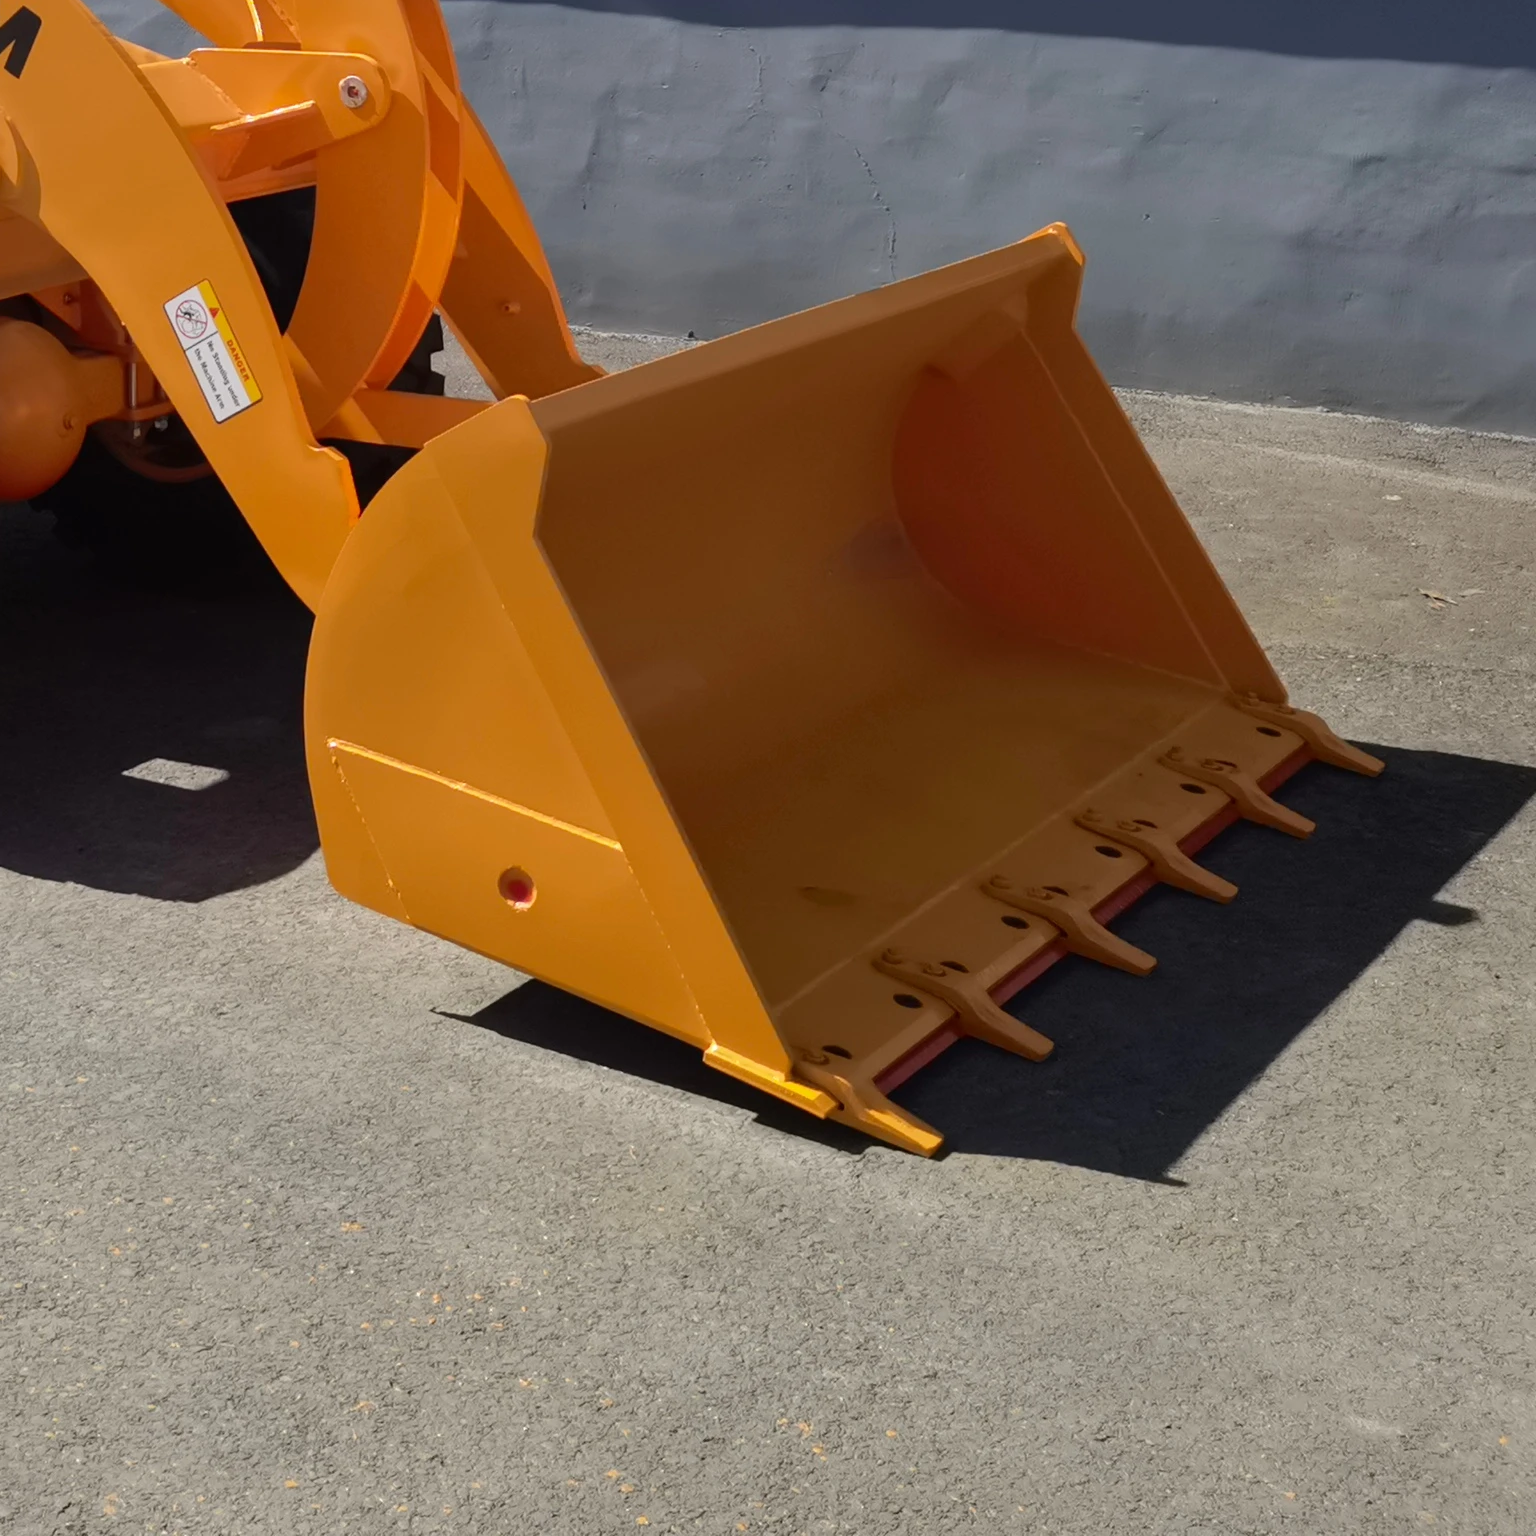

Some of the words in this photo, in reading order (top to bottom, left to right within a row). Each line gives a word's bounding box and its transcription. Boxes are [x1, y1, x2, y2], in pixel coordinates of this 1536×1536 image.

[194, 348, 203, 361] the
[200, 361, 217, 392] Machine
[215, 393, 225, 409] Arm
[207, 340, 214, 352] No
[227, 385, 240, 407] under
[227, 339, 250, 382] DANGER
